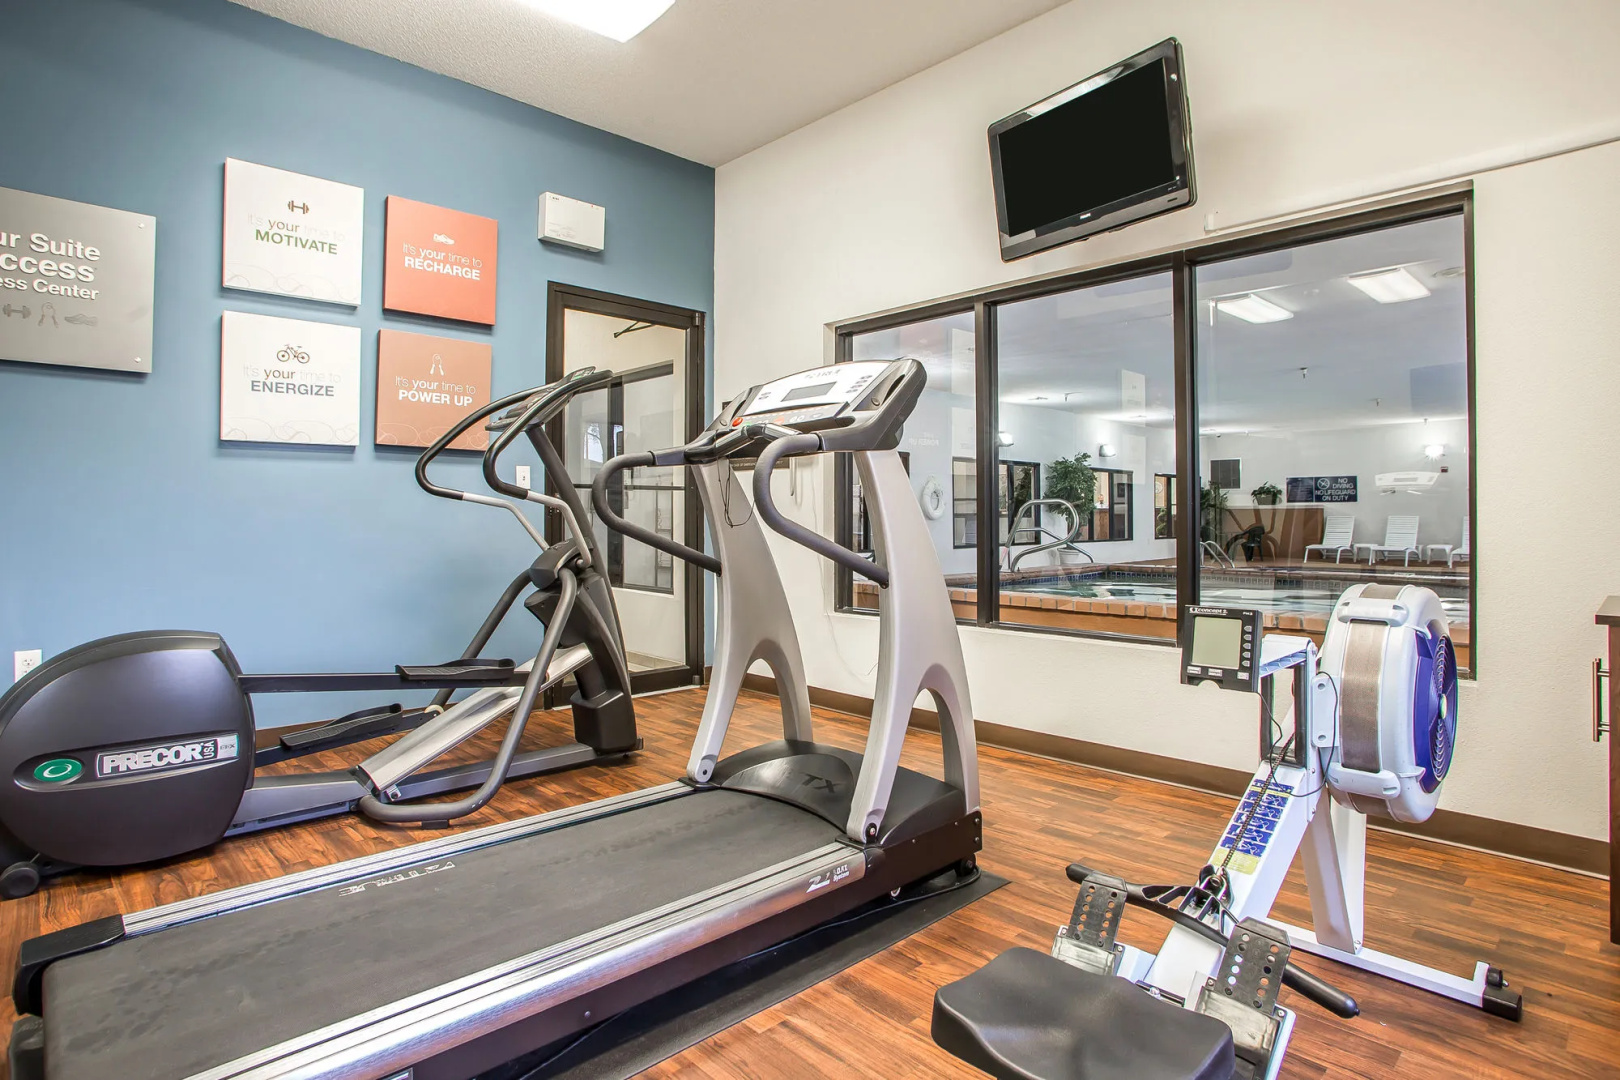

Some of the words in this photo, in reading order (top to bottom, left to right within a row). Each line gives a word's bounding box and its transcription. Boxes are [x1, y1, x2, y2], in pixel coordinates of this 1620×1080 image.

[268, 219, 300, 233] your
[30, 232, 101, 262] Suite
[255, 228, 338, 255] MOTIVATE
[402, 241, 417, 255] It's
[419, 247, 446, 261] your
[448, 252, 470, 266] time
[472, 256, 483, 268] to
[0, 253, 95, 283] ccess
[404, 256, 481, 281] RECHARGE
[0, 276, 28, 291] ss
[33, 278, 100, 300] Center
[263, 368, 296, 381] your
[395, 375, 409, 388] It's
[412, 379, 439, 391] your
[441, 381, 464, 393] time
[466, 384, 477, 395] to
[250, 380, 335, 397] ENERGIZE
[398, 389, 451, 405] POWER
[454, 394, 473, 407] UP
[103, 744, 203, 774] PRECOR
[203, 740, 215, 759] USA
